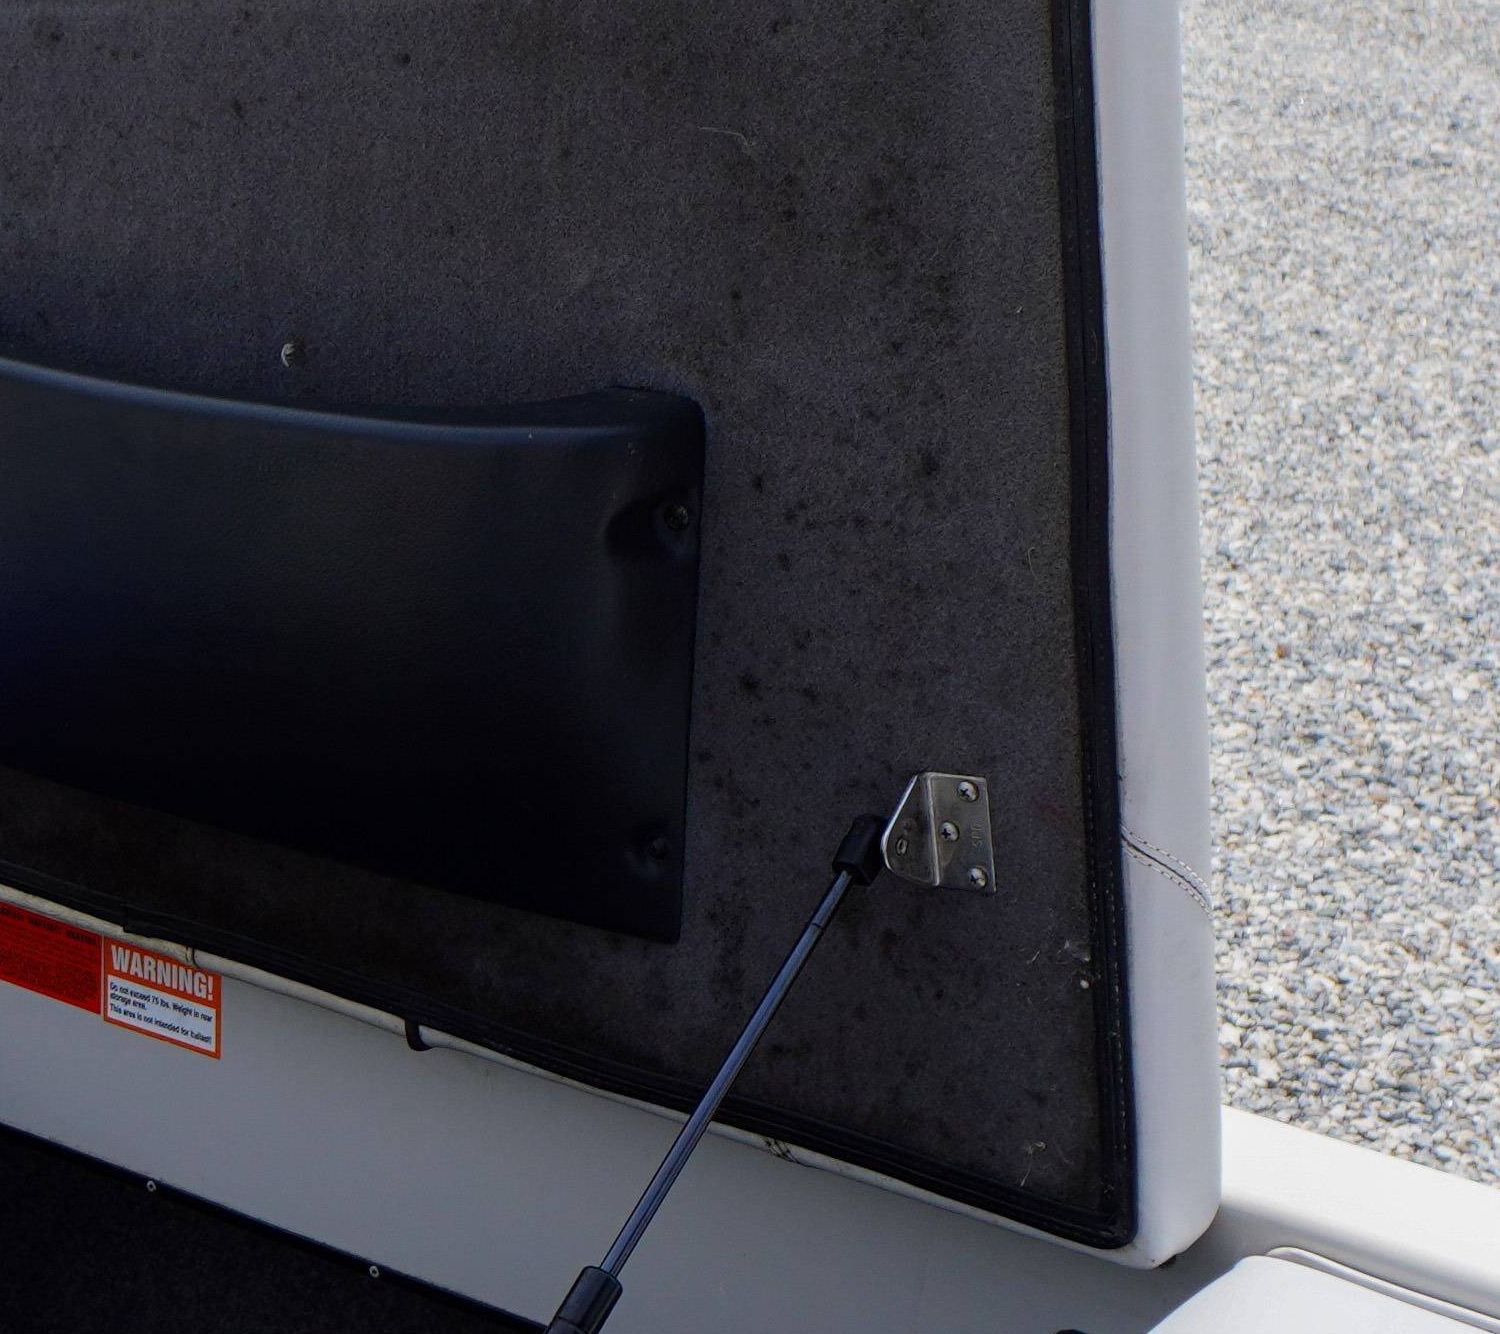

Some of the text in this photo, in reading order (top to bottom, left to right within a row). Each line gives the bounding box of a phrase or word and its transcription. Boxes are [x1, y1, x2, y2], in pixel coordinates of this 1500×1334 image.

[111, 944, 213, 1001] WARNING!
[119, 984, 128, 995] not
[130, 987, 150, 1002] exceed
[110, 1002, 121, 1014] This
[123, 1007, 135, 1019] area
[137, 1011, 141, 1021] is
[143, 1013, 152, 1024] not
[154, 1017, 179, 1033] intended
[180, 1025, 188, 1036] for
